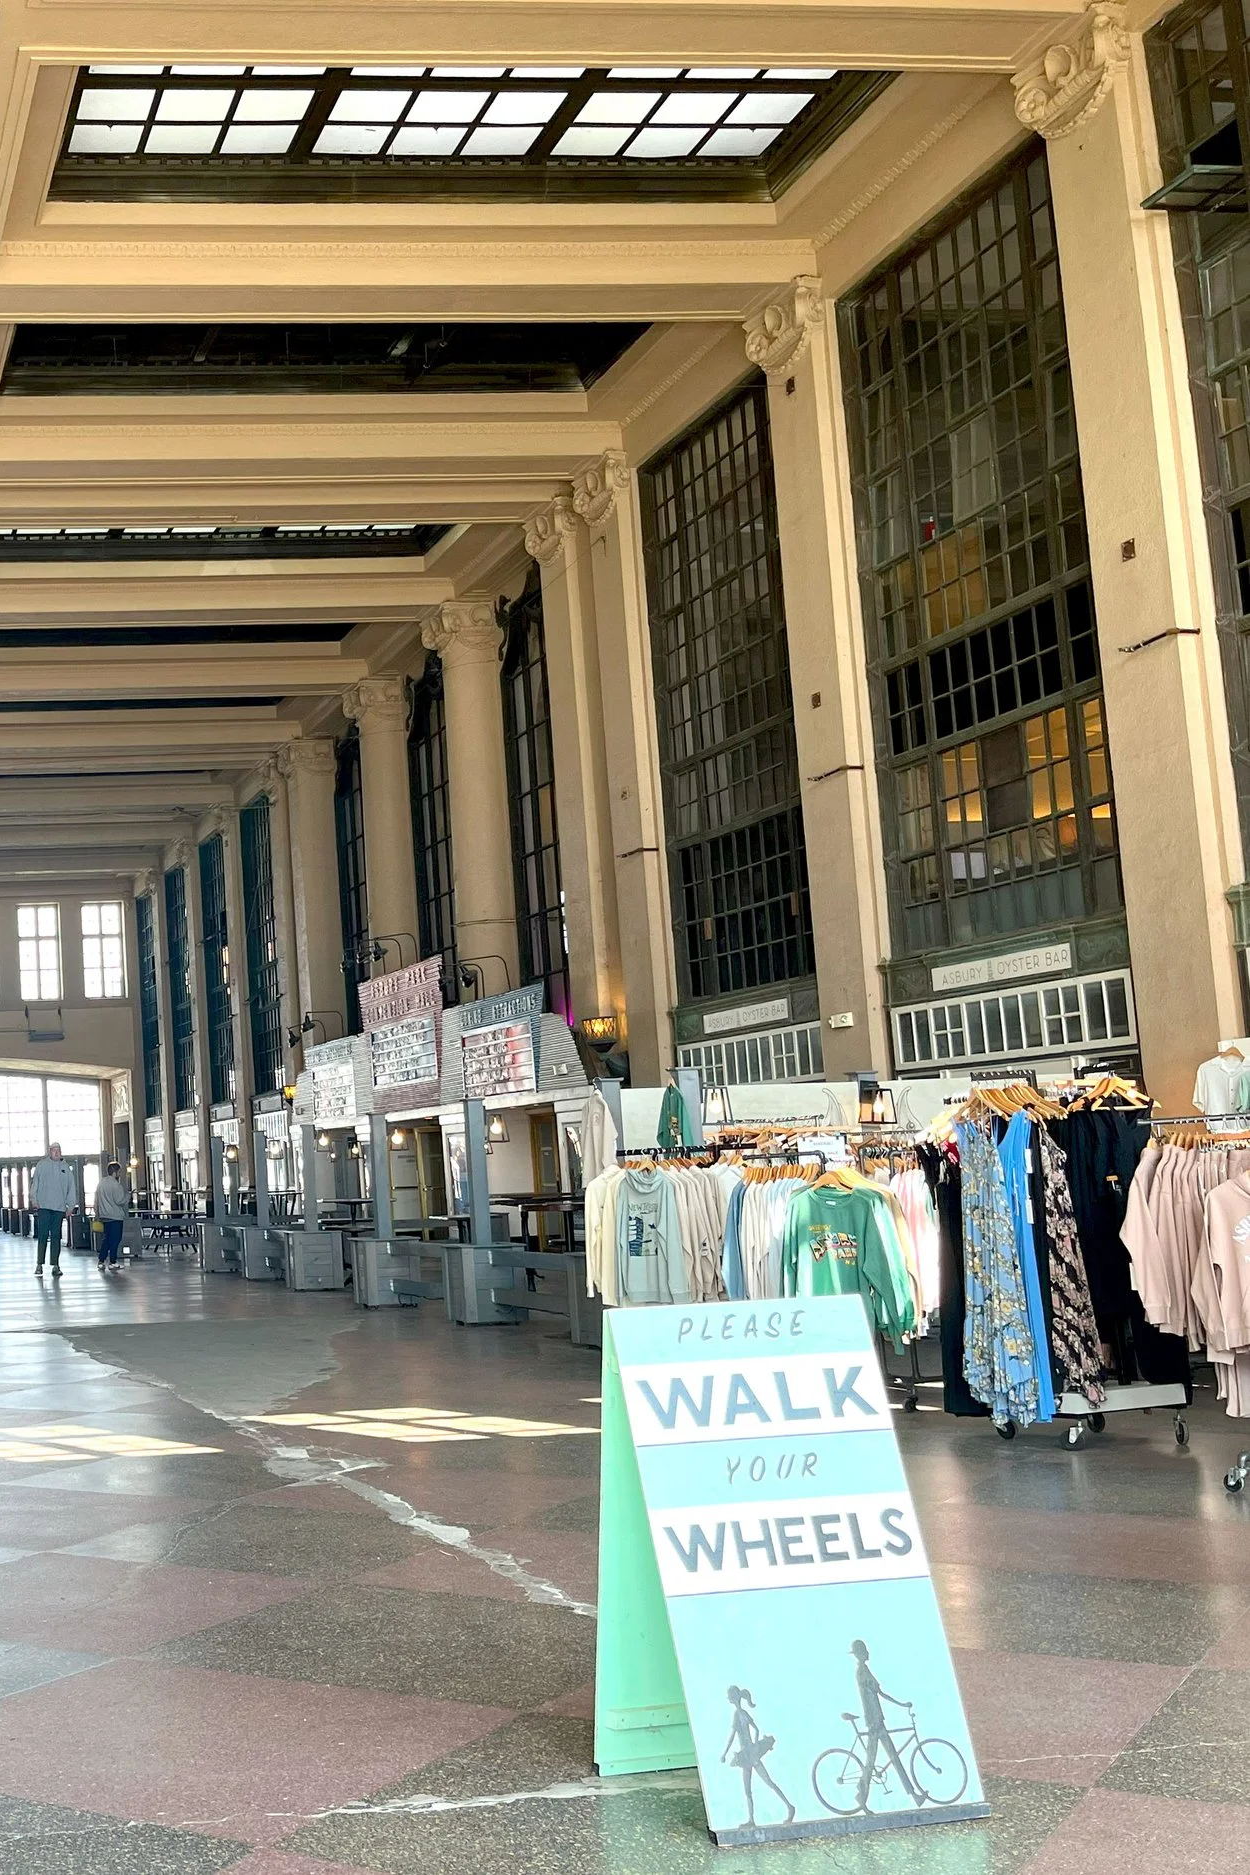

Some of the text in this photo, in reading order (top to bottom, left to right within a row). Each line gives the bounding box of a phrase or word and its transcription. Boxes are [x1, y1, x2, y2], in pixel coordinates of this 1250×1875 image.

[942, 949, 1069, 986] ASBURY OYSTER BAR
[742, 1007, 769, 1022] OYSTER
[771, 1003, 785, 1016] BAR
[677, 1310, 807, 1343] PLEASE
[636, 1365, 878, 1429] WALK
[726, 1451, 819, 1484] YOUR
[662, 1507, 913, 1573] WHEELS
